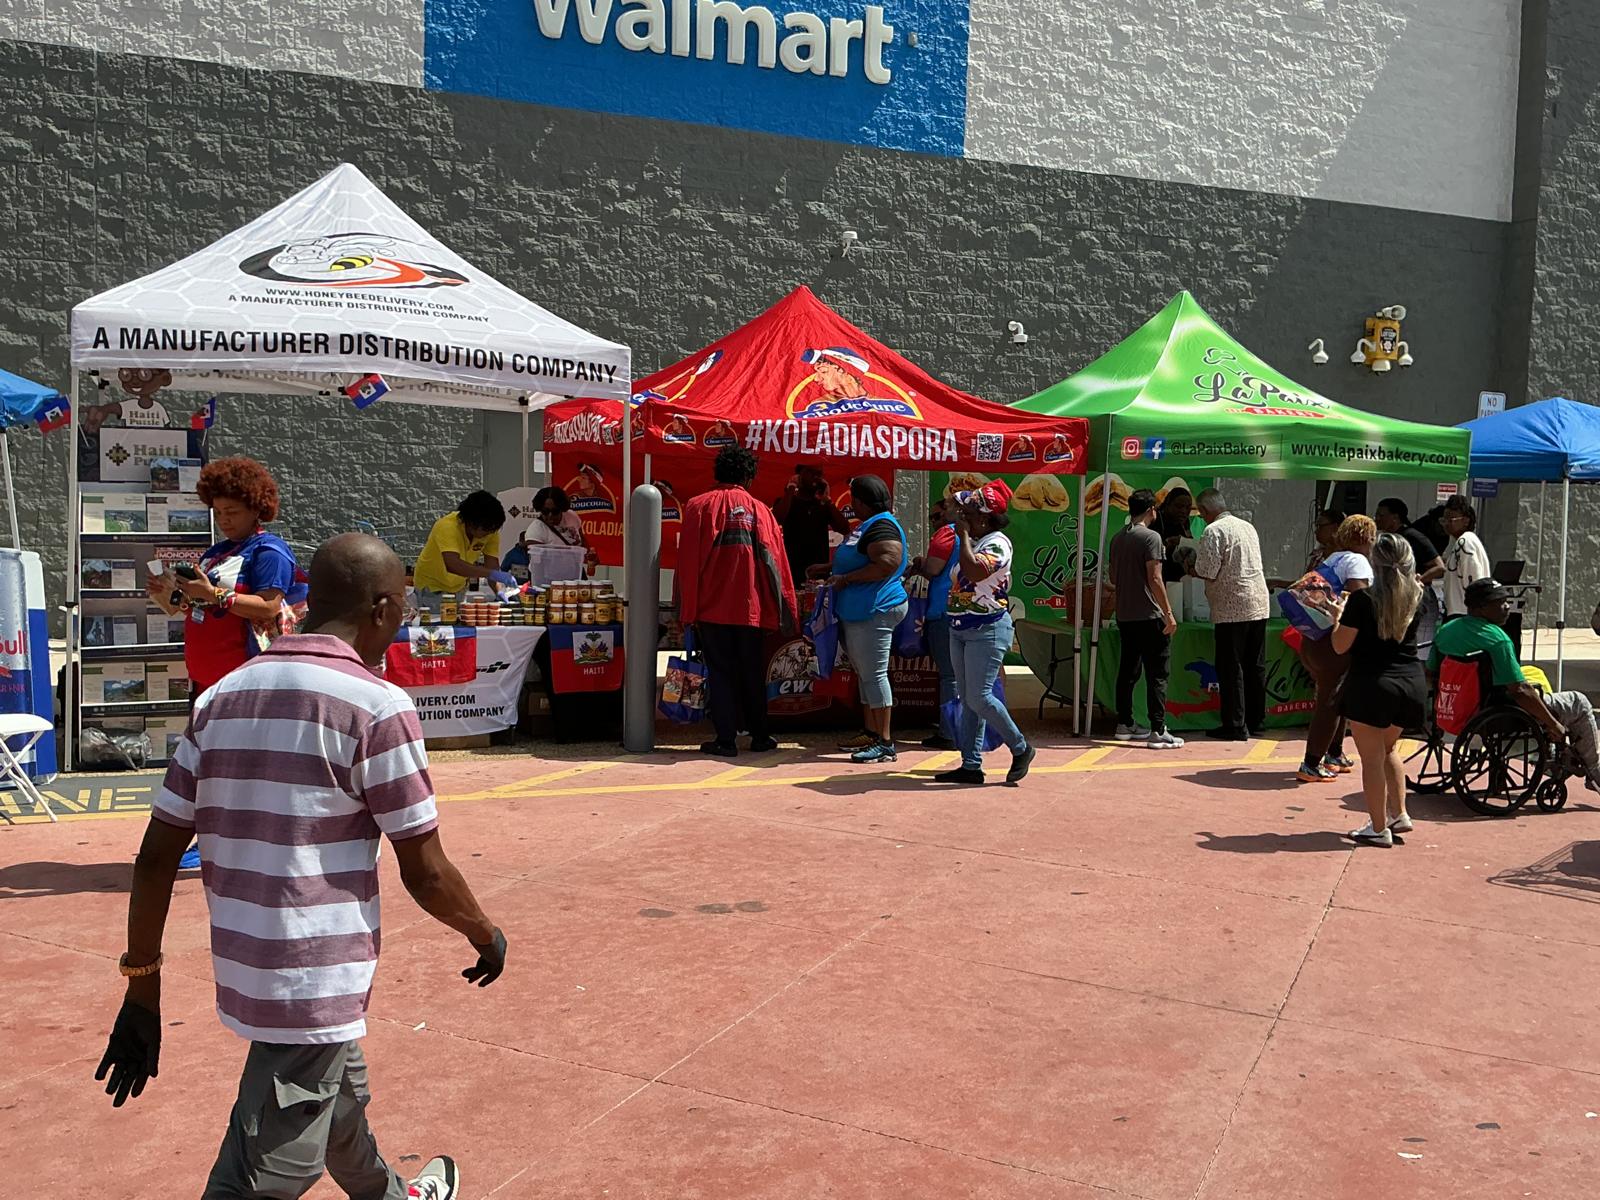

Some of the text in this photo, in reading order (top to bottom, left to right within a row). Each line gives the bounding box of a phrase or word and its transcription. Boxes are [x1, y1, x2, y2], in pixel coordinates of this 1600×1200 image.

[534, 0, 893, 84] Walmart
[265, 287, 455, 312] WWW.HONEYBEEDELIVERY.COM
[241, 295, 343, 309] MANUFACTURER
[346, 301, 430, 317] DISTRIBUTION
[433, 310, 490, 323] COMPANY
[92, 327, 618, 384] A MANUFACTURER DISTRIBUTION COMPANY
[1486, 396, 1498, 408] NO
[128, 410, 160, 419] Haiti
[745, 418, 959, 462] #KOLADIASPORA
[133, 444, 179, 456] Haiti
[1170, 440, 1267, 458] @LaPaixBakery
[1291, 442, 1459, 467] www.lapaixbakery.com
[160, 551, 205, 559] MONOPOLY
[0, 629, 28, 656] ull
[421, 660, 447, 669] HAITI
[583, 666, 605, 675] HAITI
[416, 694, 476, 707] IVERY.COM
[417, 705, 506, 721] UTION COMPANY
